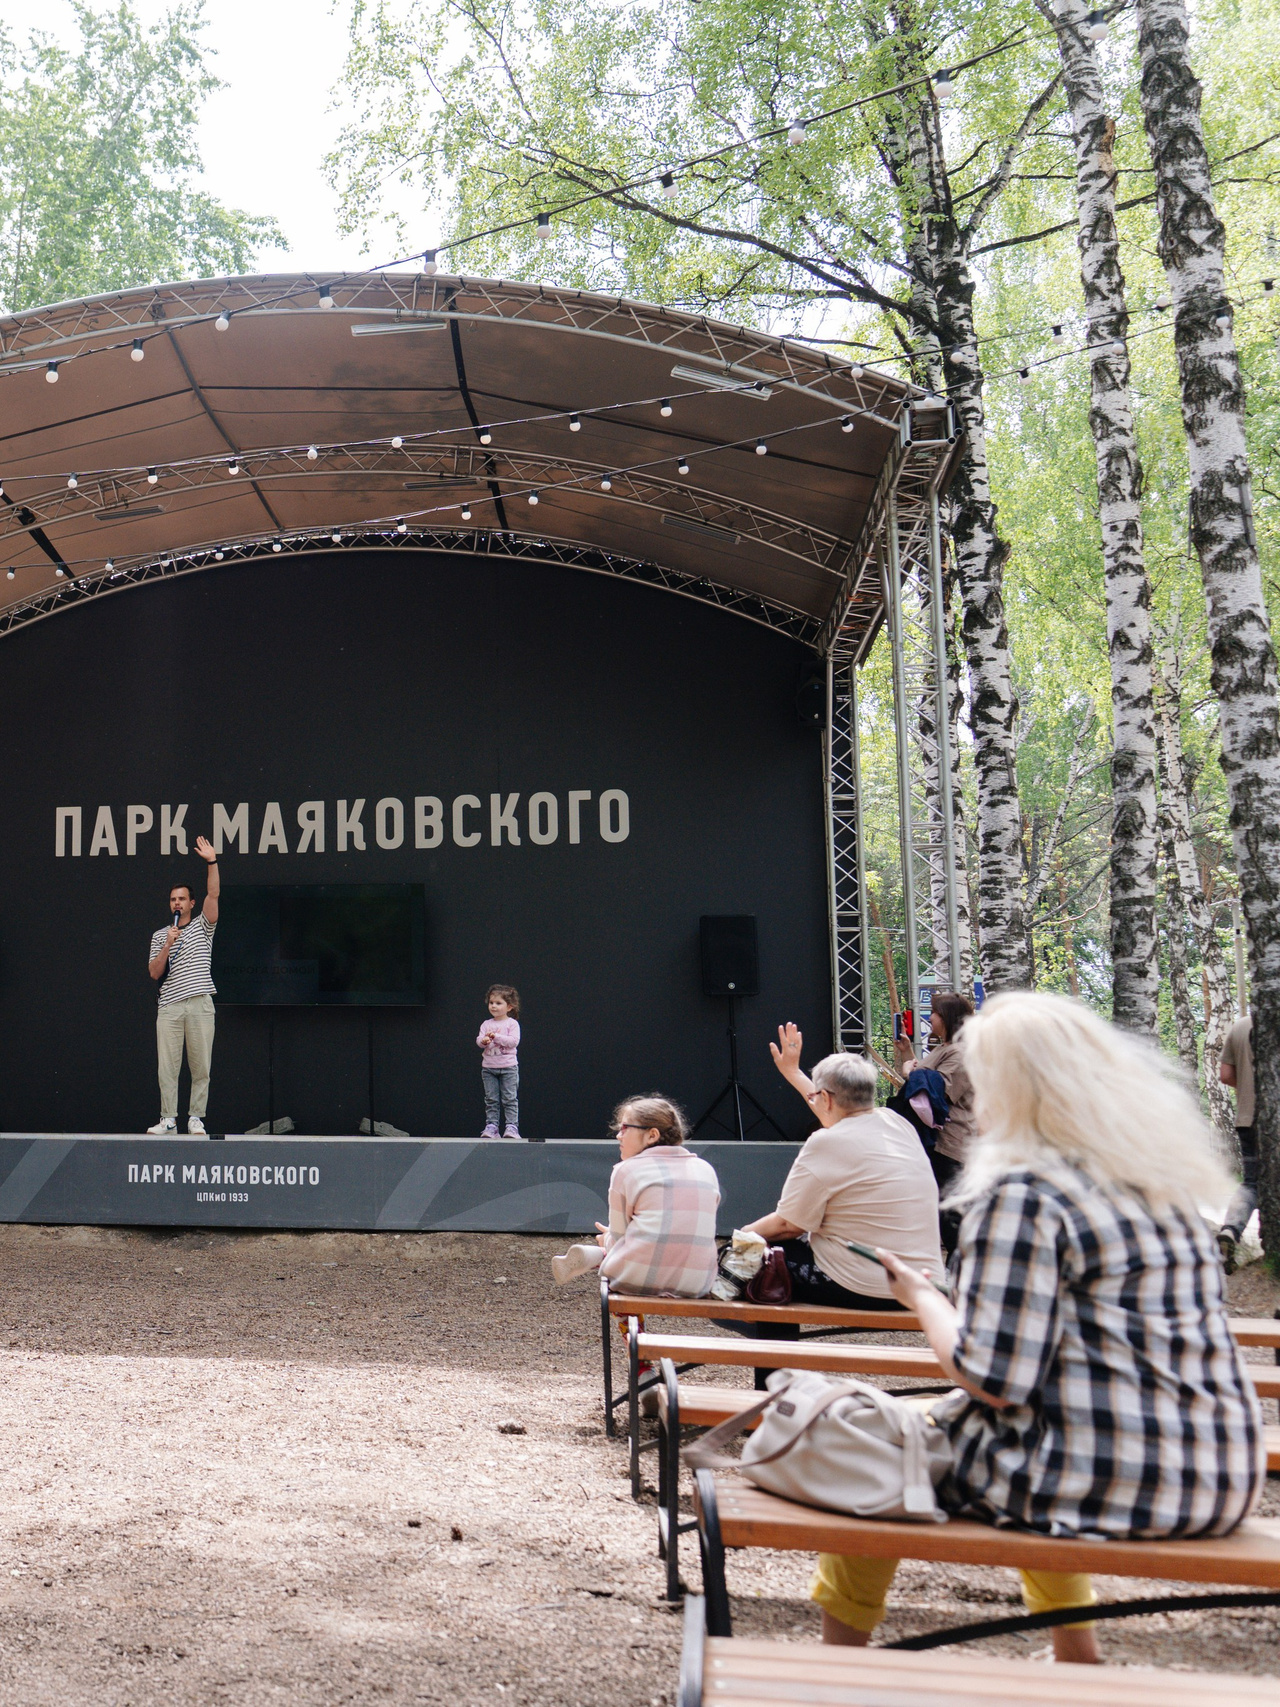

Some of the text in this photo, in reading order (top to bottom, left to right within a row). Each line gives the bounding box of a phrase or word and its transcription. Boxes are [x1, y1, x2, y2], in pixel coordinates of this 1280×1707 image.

[55, 788, 630, 857] ПАРК МАЯКОВСКОГО
[128, 1164, 320, 1186] ПАРК МАЯКОВСКОГО
[196, 1192, 249, 1203] ЦПКиО 1933
